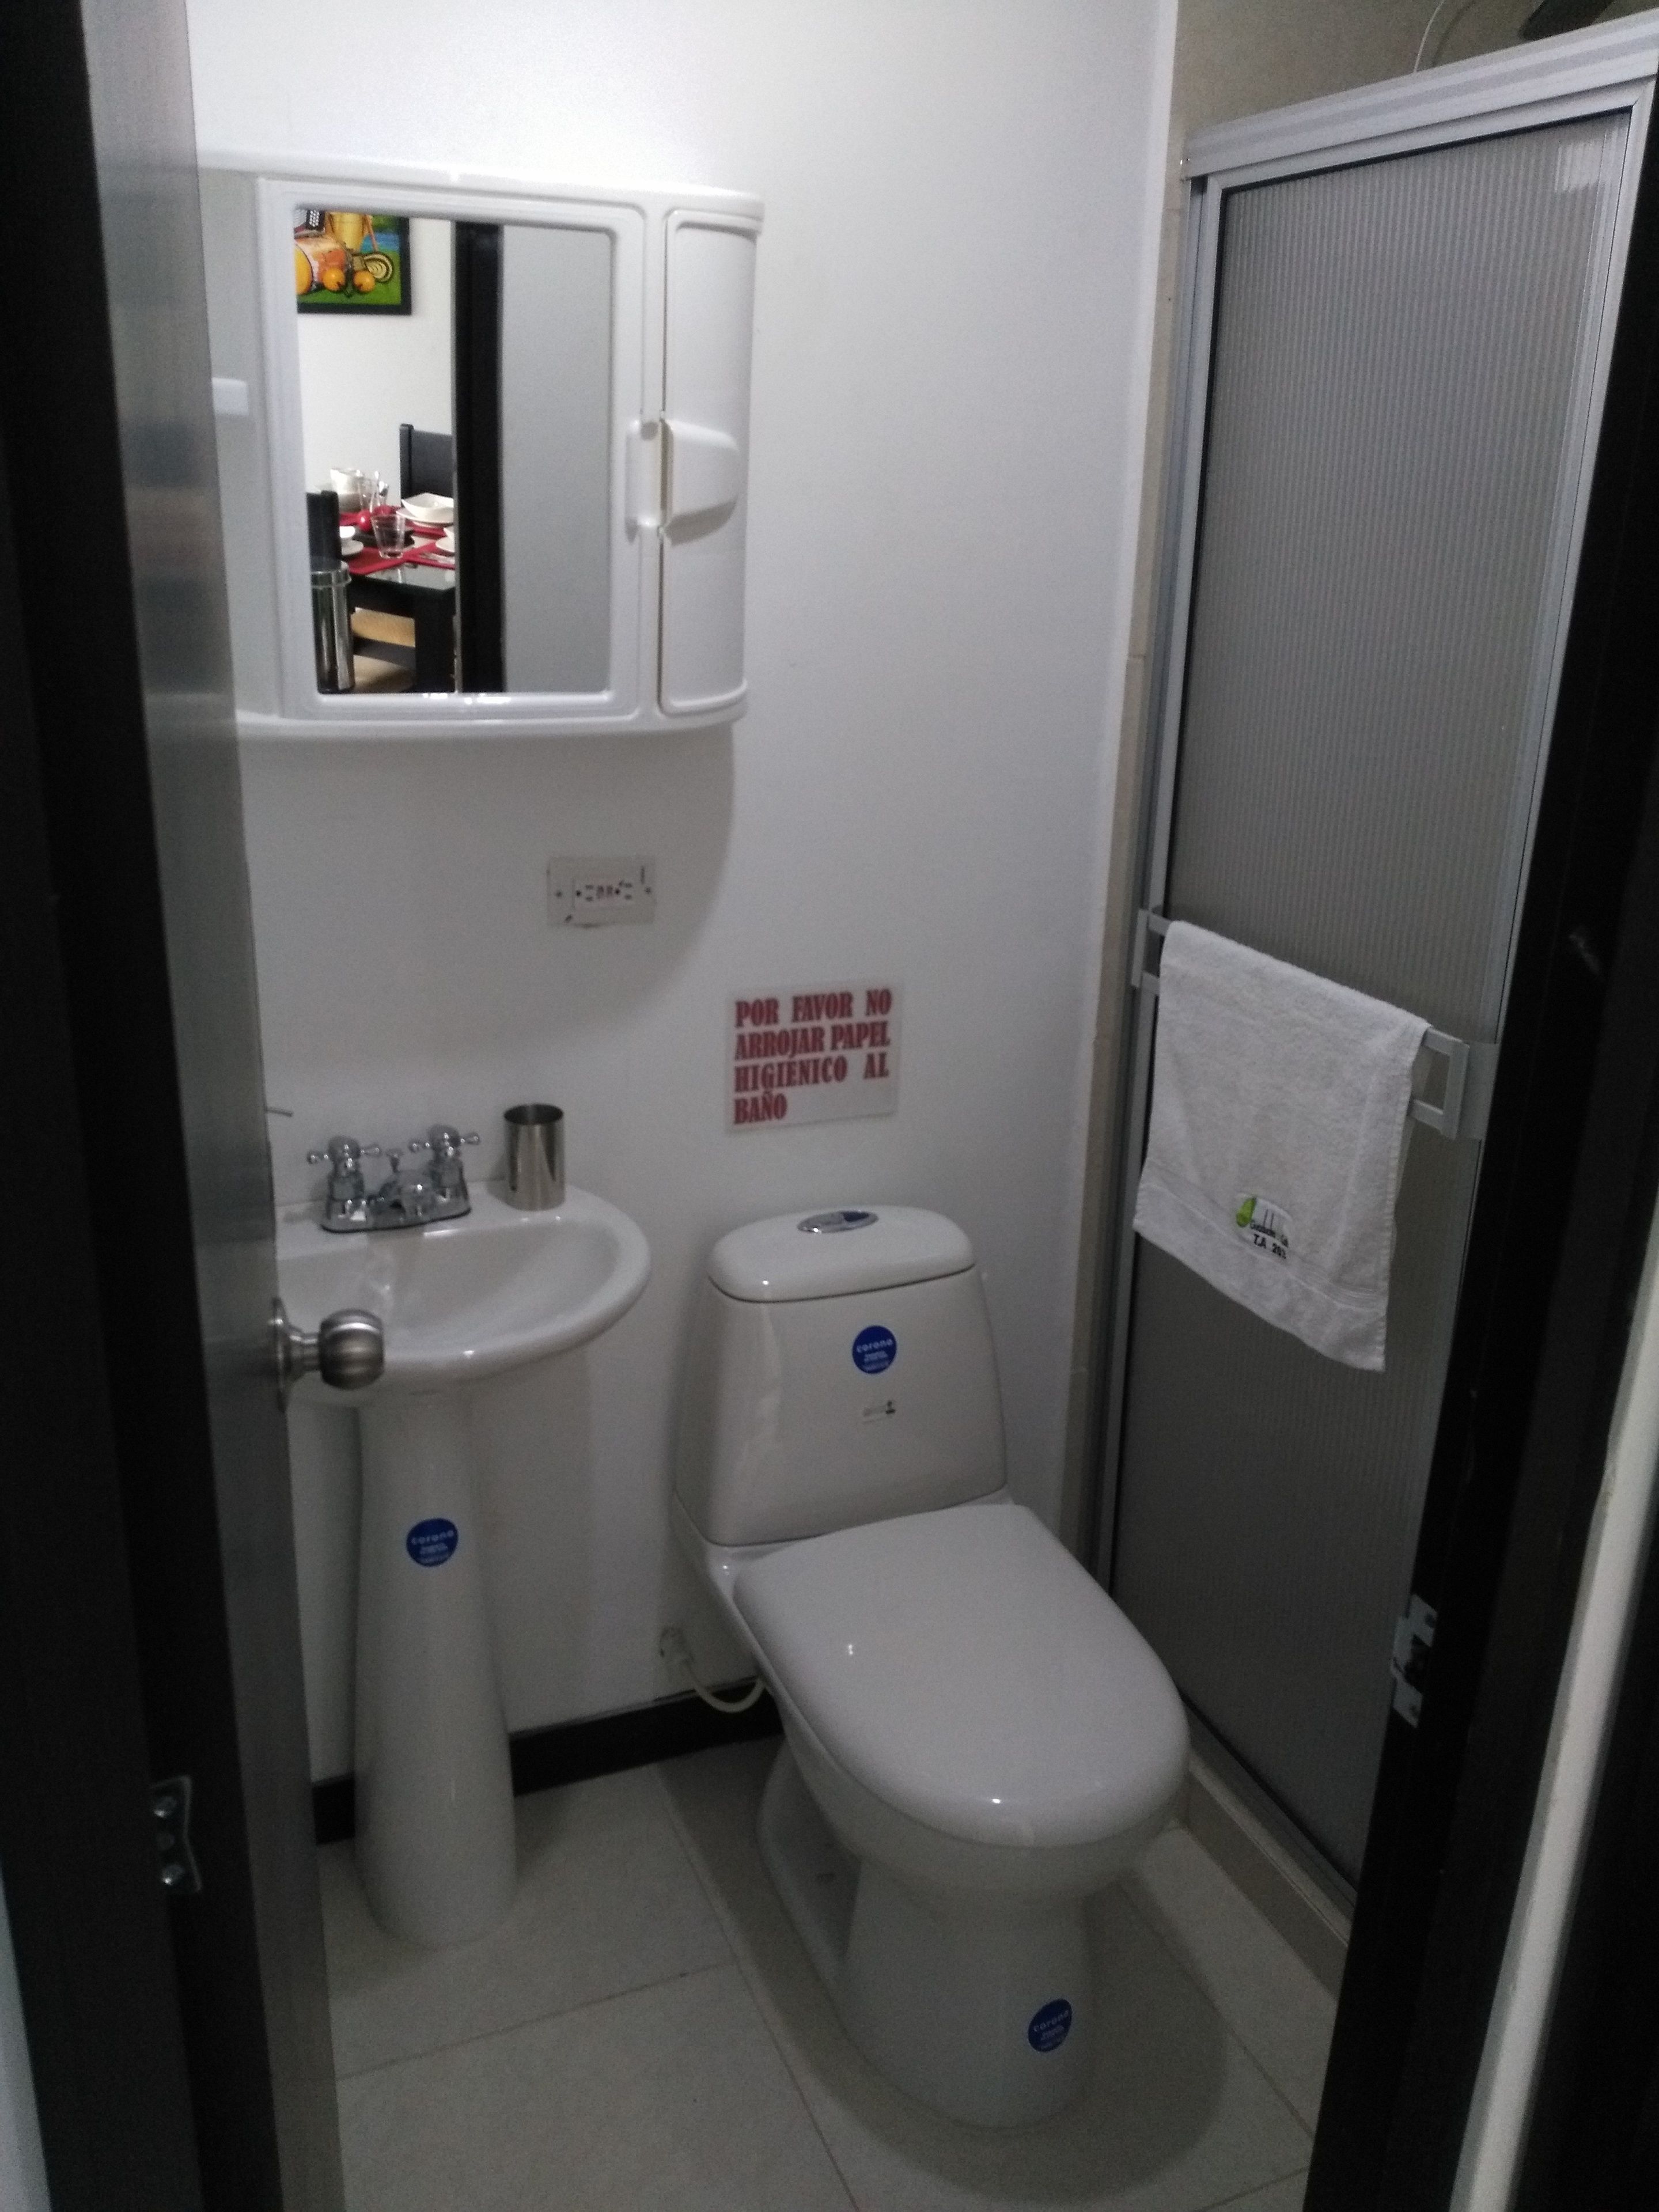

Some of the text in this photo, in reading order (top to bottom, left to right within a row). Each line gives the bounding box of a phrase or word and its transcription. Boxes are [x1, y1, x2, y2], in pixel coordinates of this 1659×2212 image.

[734, 988, 892, 1027] POR FAVOR NO
[734, 1021, 890, 1059] ARROJAR PAPEL
[734, 1052, 888, 1092] HIGIENICO AL
[734, 1092, 787, 1124] BAÑO
